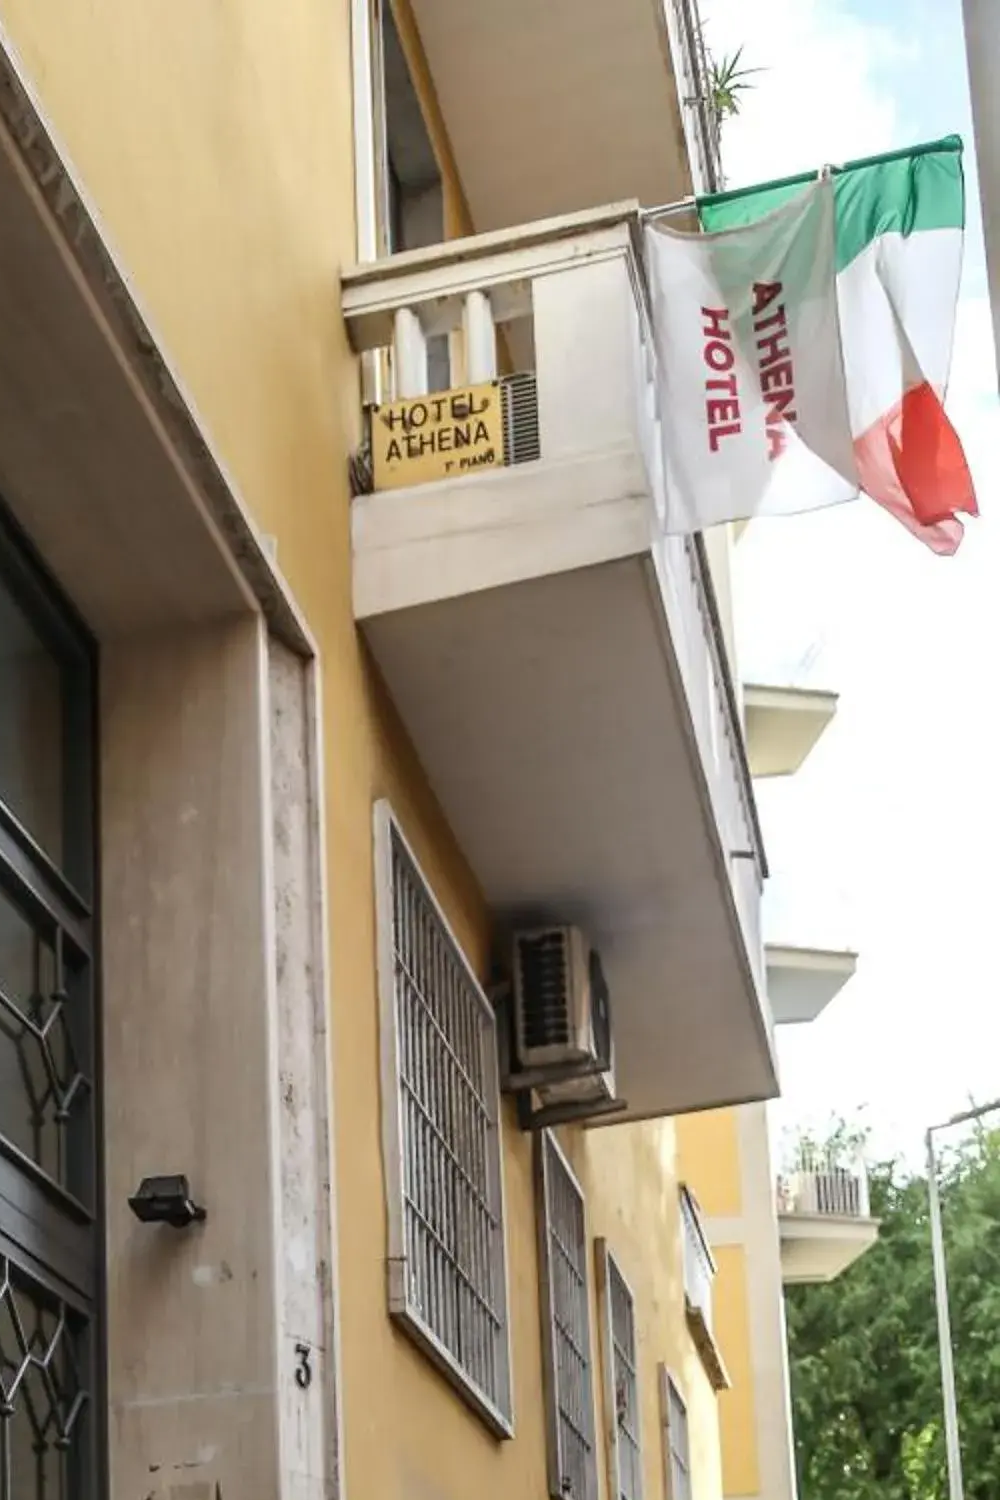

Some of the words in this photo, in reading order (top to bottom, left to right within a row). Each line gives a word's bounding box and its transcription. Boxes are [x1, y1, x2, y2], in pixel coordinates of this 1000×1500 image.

[701, 306, 742, 452] HOTEL
[752, 281, 798, 462] ATHENA
[387, 391, 490, 432] HOTEL
[385, 420, 490, 463] ATHENA
[295, 1343, 311, 1389] 3
